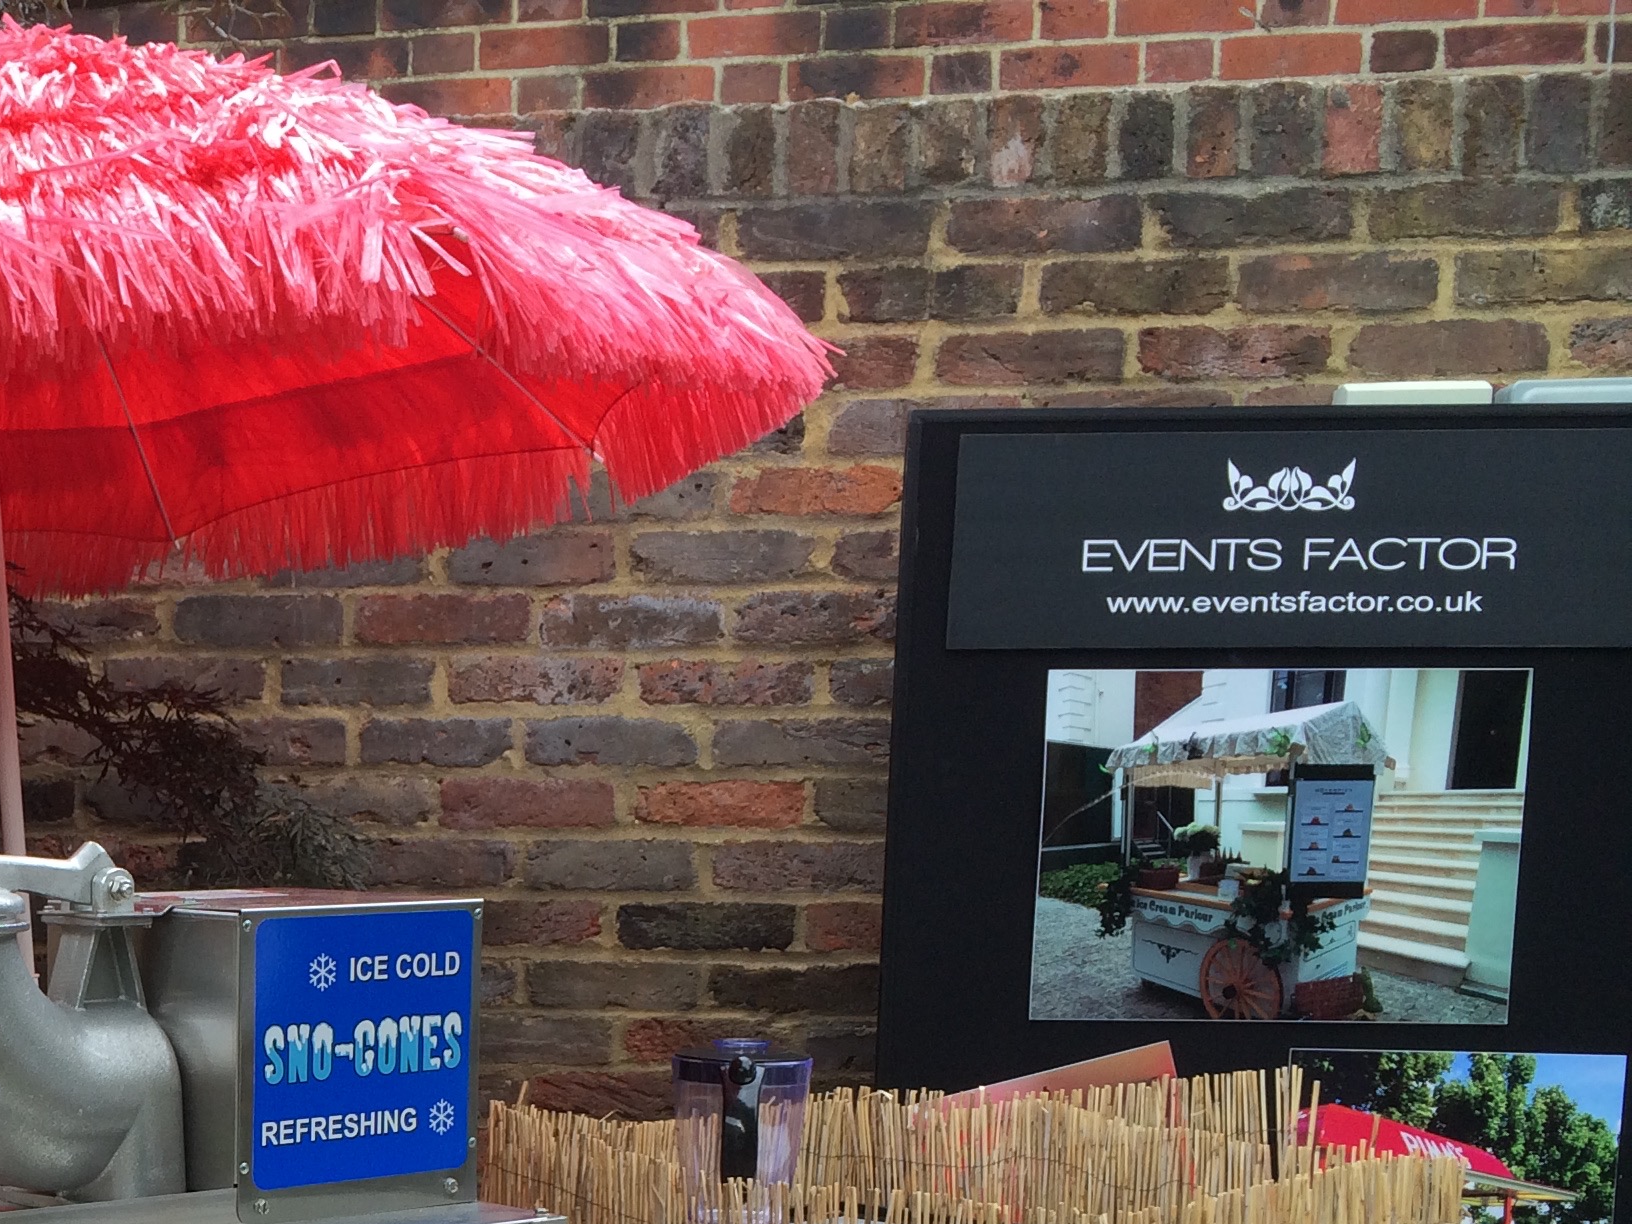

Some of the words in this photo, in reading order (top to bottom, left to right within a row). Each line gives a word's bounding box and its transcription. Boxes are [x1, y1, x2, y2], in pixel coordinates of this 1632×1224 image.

[1081, 538, 1283, 573] EVENTS
[1302, 536, 1518, 571] FACTOR
[1106, 590, 1484, 615] www.eventsfactor.co.uk
[348, 955, 389, 982] ICE
[395, 951, 461, 979] COLD
[263, 1011, 463, 1085] SNO-CONES
[260, 1107, 418, 1147] REFRESHING
